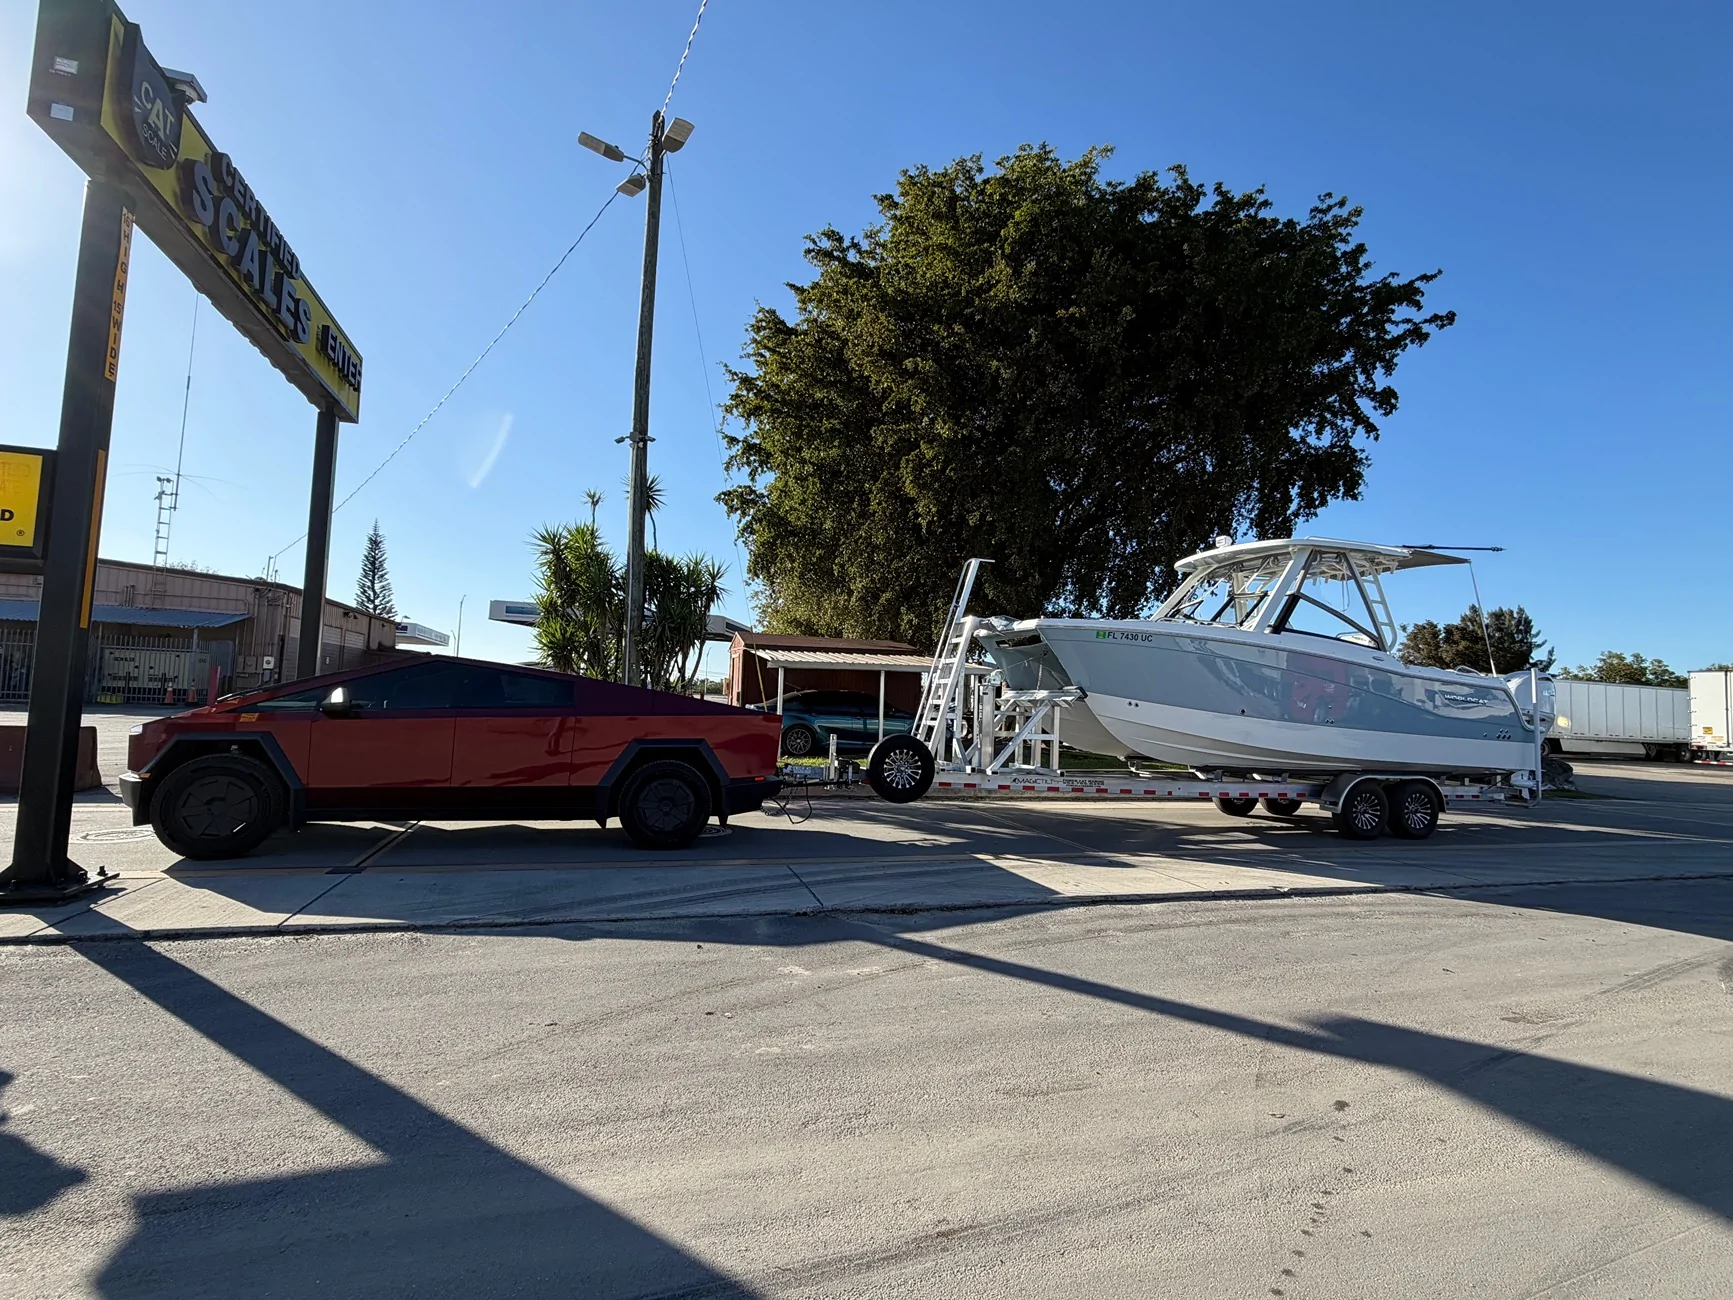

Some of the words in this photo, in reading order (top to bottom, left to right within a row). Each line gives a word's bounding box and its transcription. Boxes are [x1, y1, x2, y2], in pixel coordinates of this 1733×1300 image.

[141, 81, 174, 141] CAT
[142, 123, 167, 161] SCALE
[219, 152, 301, 280] CERTIFIED
[117, 230, 129, 294] HIGH
[192, 160, 311, 345] SCALES
[108, 316, 121, 376] WIDE
[326, 325, 362, 389] ENTER
[1107, 631, 1118, 640] FL
[1120, 632, 1139, 642] 7430
[1140, 634, 1153, 643] UC
